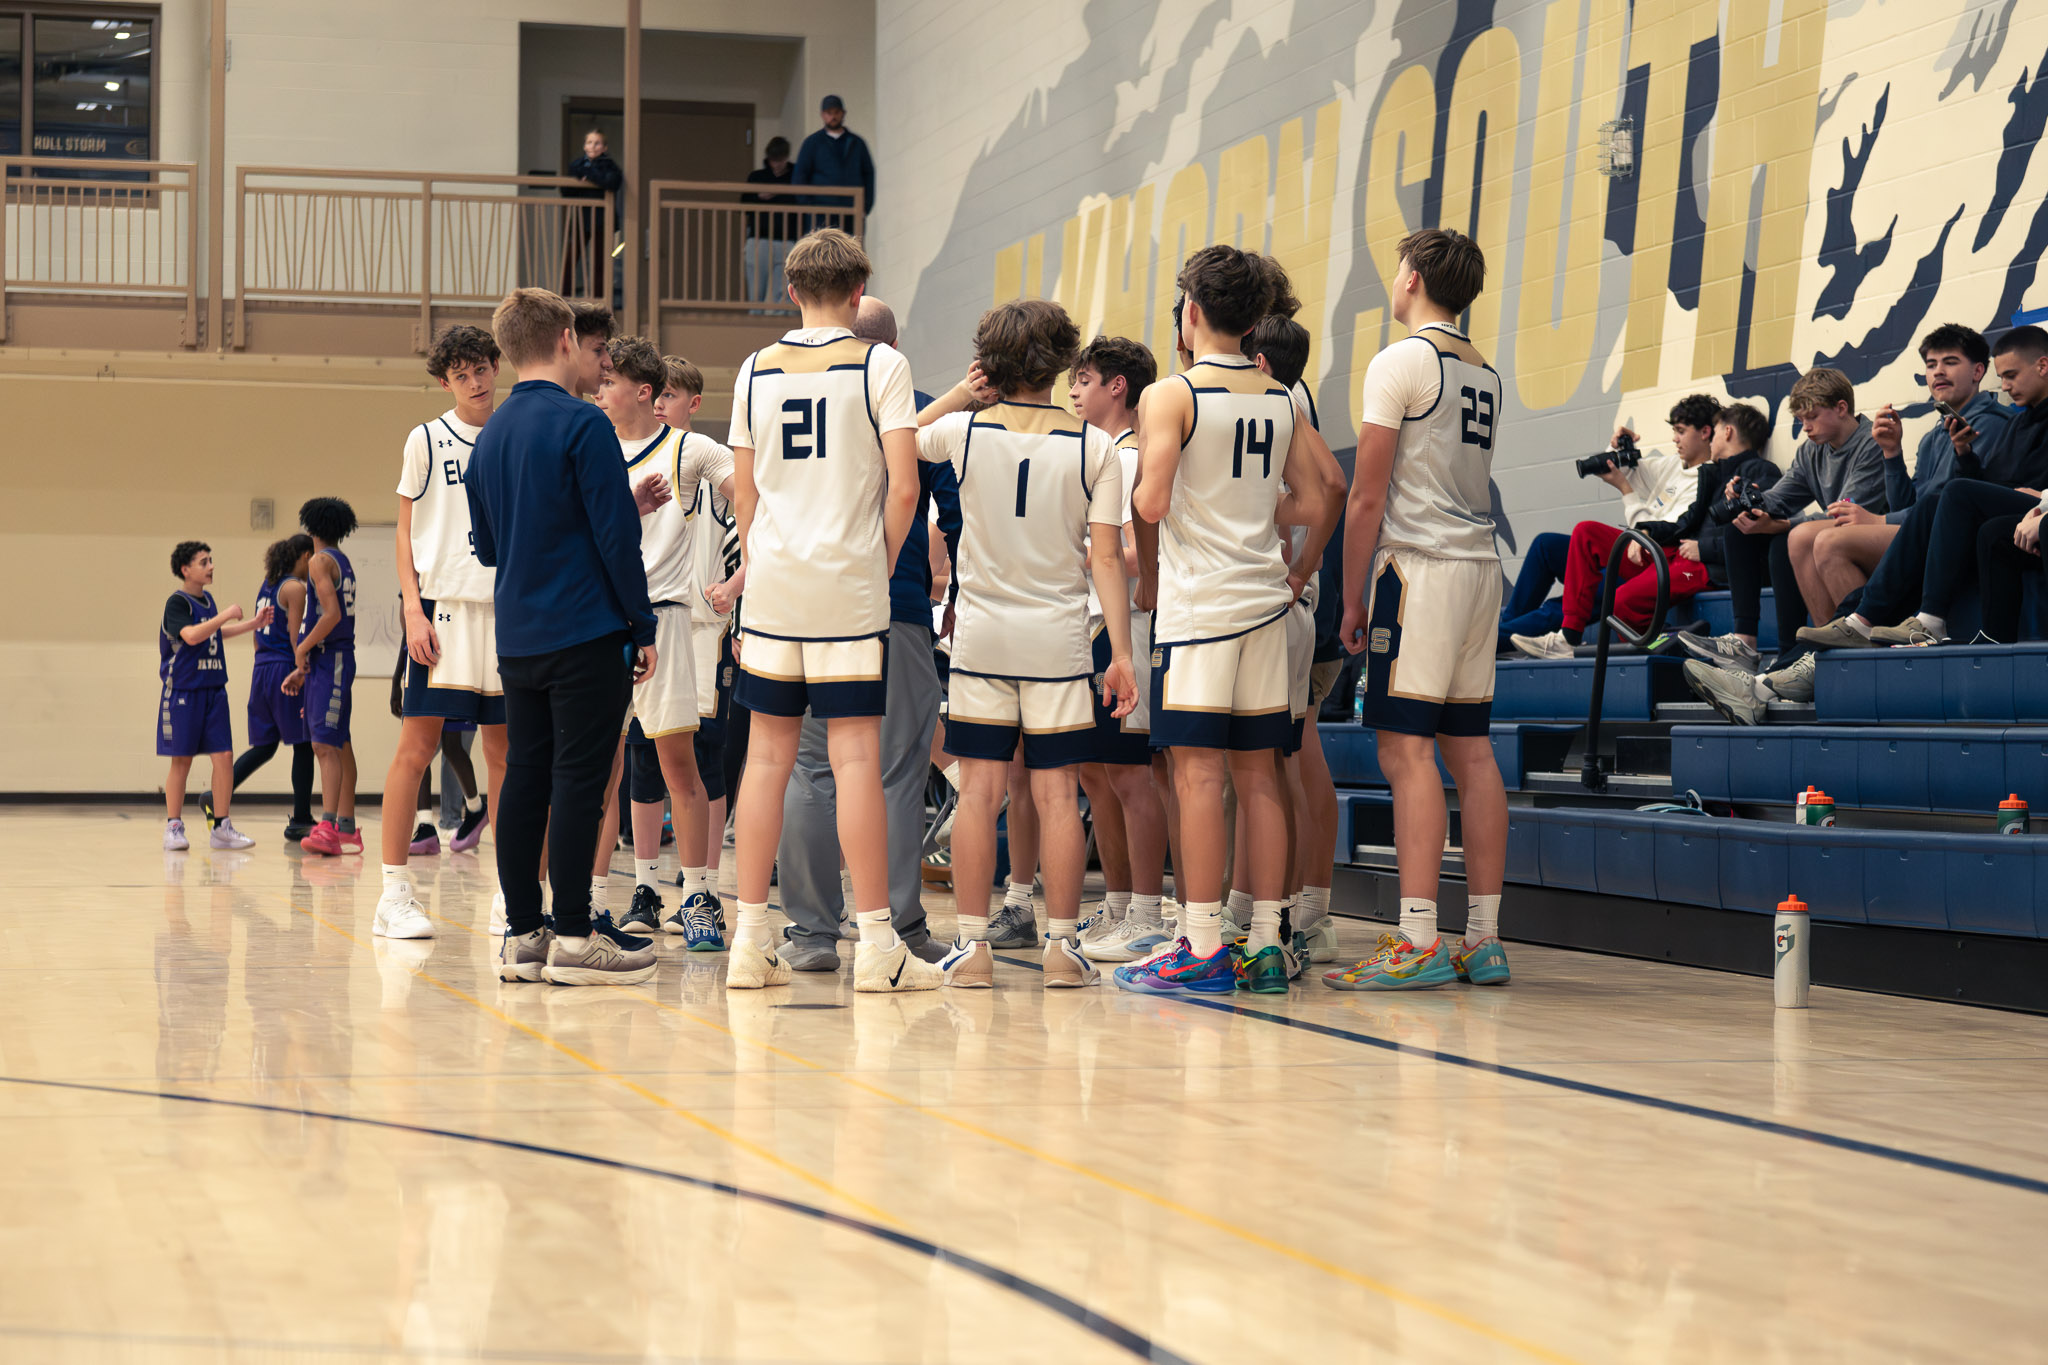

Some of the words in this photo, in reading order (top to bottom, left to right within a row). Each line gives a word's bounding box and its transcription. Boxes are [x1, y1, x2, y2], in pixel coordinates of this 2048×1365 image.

[34, 136, 63, 150] ROLL
[65, 137, 107, 152] STORM
[1348, 0, 1828, 440] SOUTH
[782, 398, 826, 460] 21
[1461, 385, 1493, 449] 23
[1232, 418, 1274, 479] 14
[1015, 458, 1031, 518] 1
